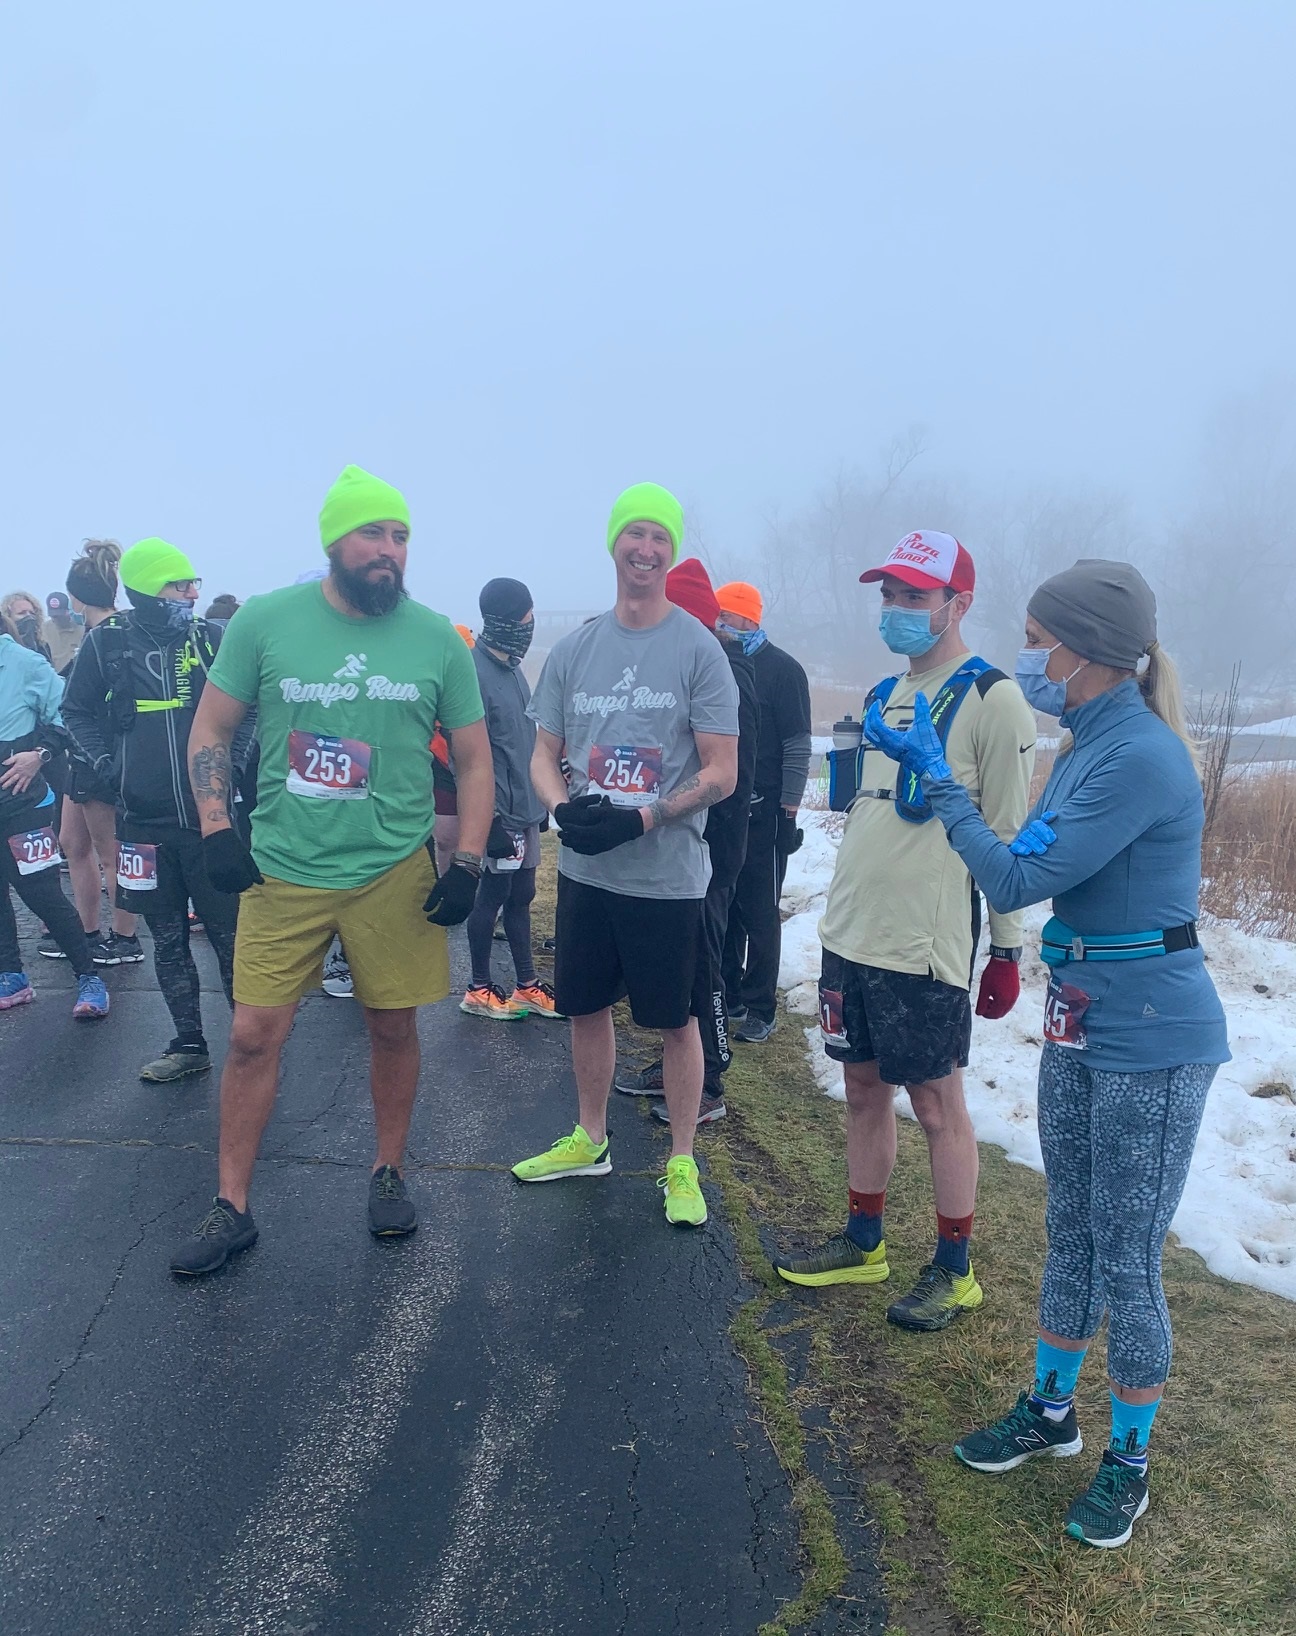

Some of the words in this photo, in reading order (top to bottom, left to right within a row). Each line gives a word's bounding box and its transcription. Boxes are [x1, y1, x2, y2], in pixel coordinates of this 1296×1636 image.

[888, 547, 929, 565] Planet
[903, 533, 940, 558] Pizza
[175, 664, 191, 704] RAGNA
[279, 677, 359, 708] Tempo
[365, 675, 421, 702] Run
[573, 692, 628, 718] Tempo
[631, 686, 677, 709] Run
[305, 749, 351, 784] 253
[603, 759, 644, 789] 254
[23, 837, 51, 861] 229
[119, 852, 143, 876] 250
[713, 991, 723, 1015] new
